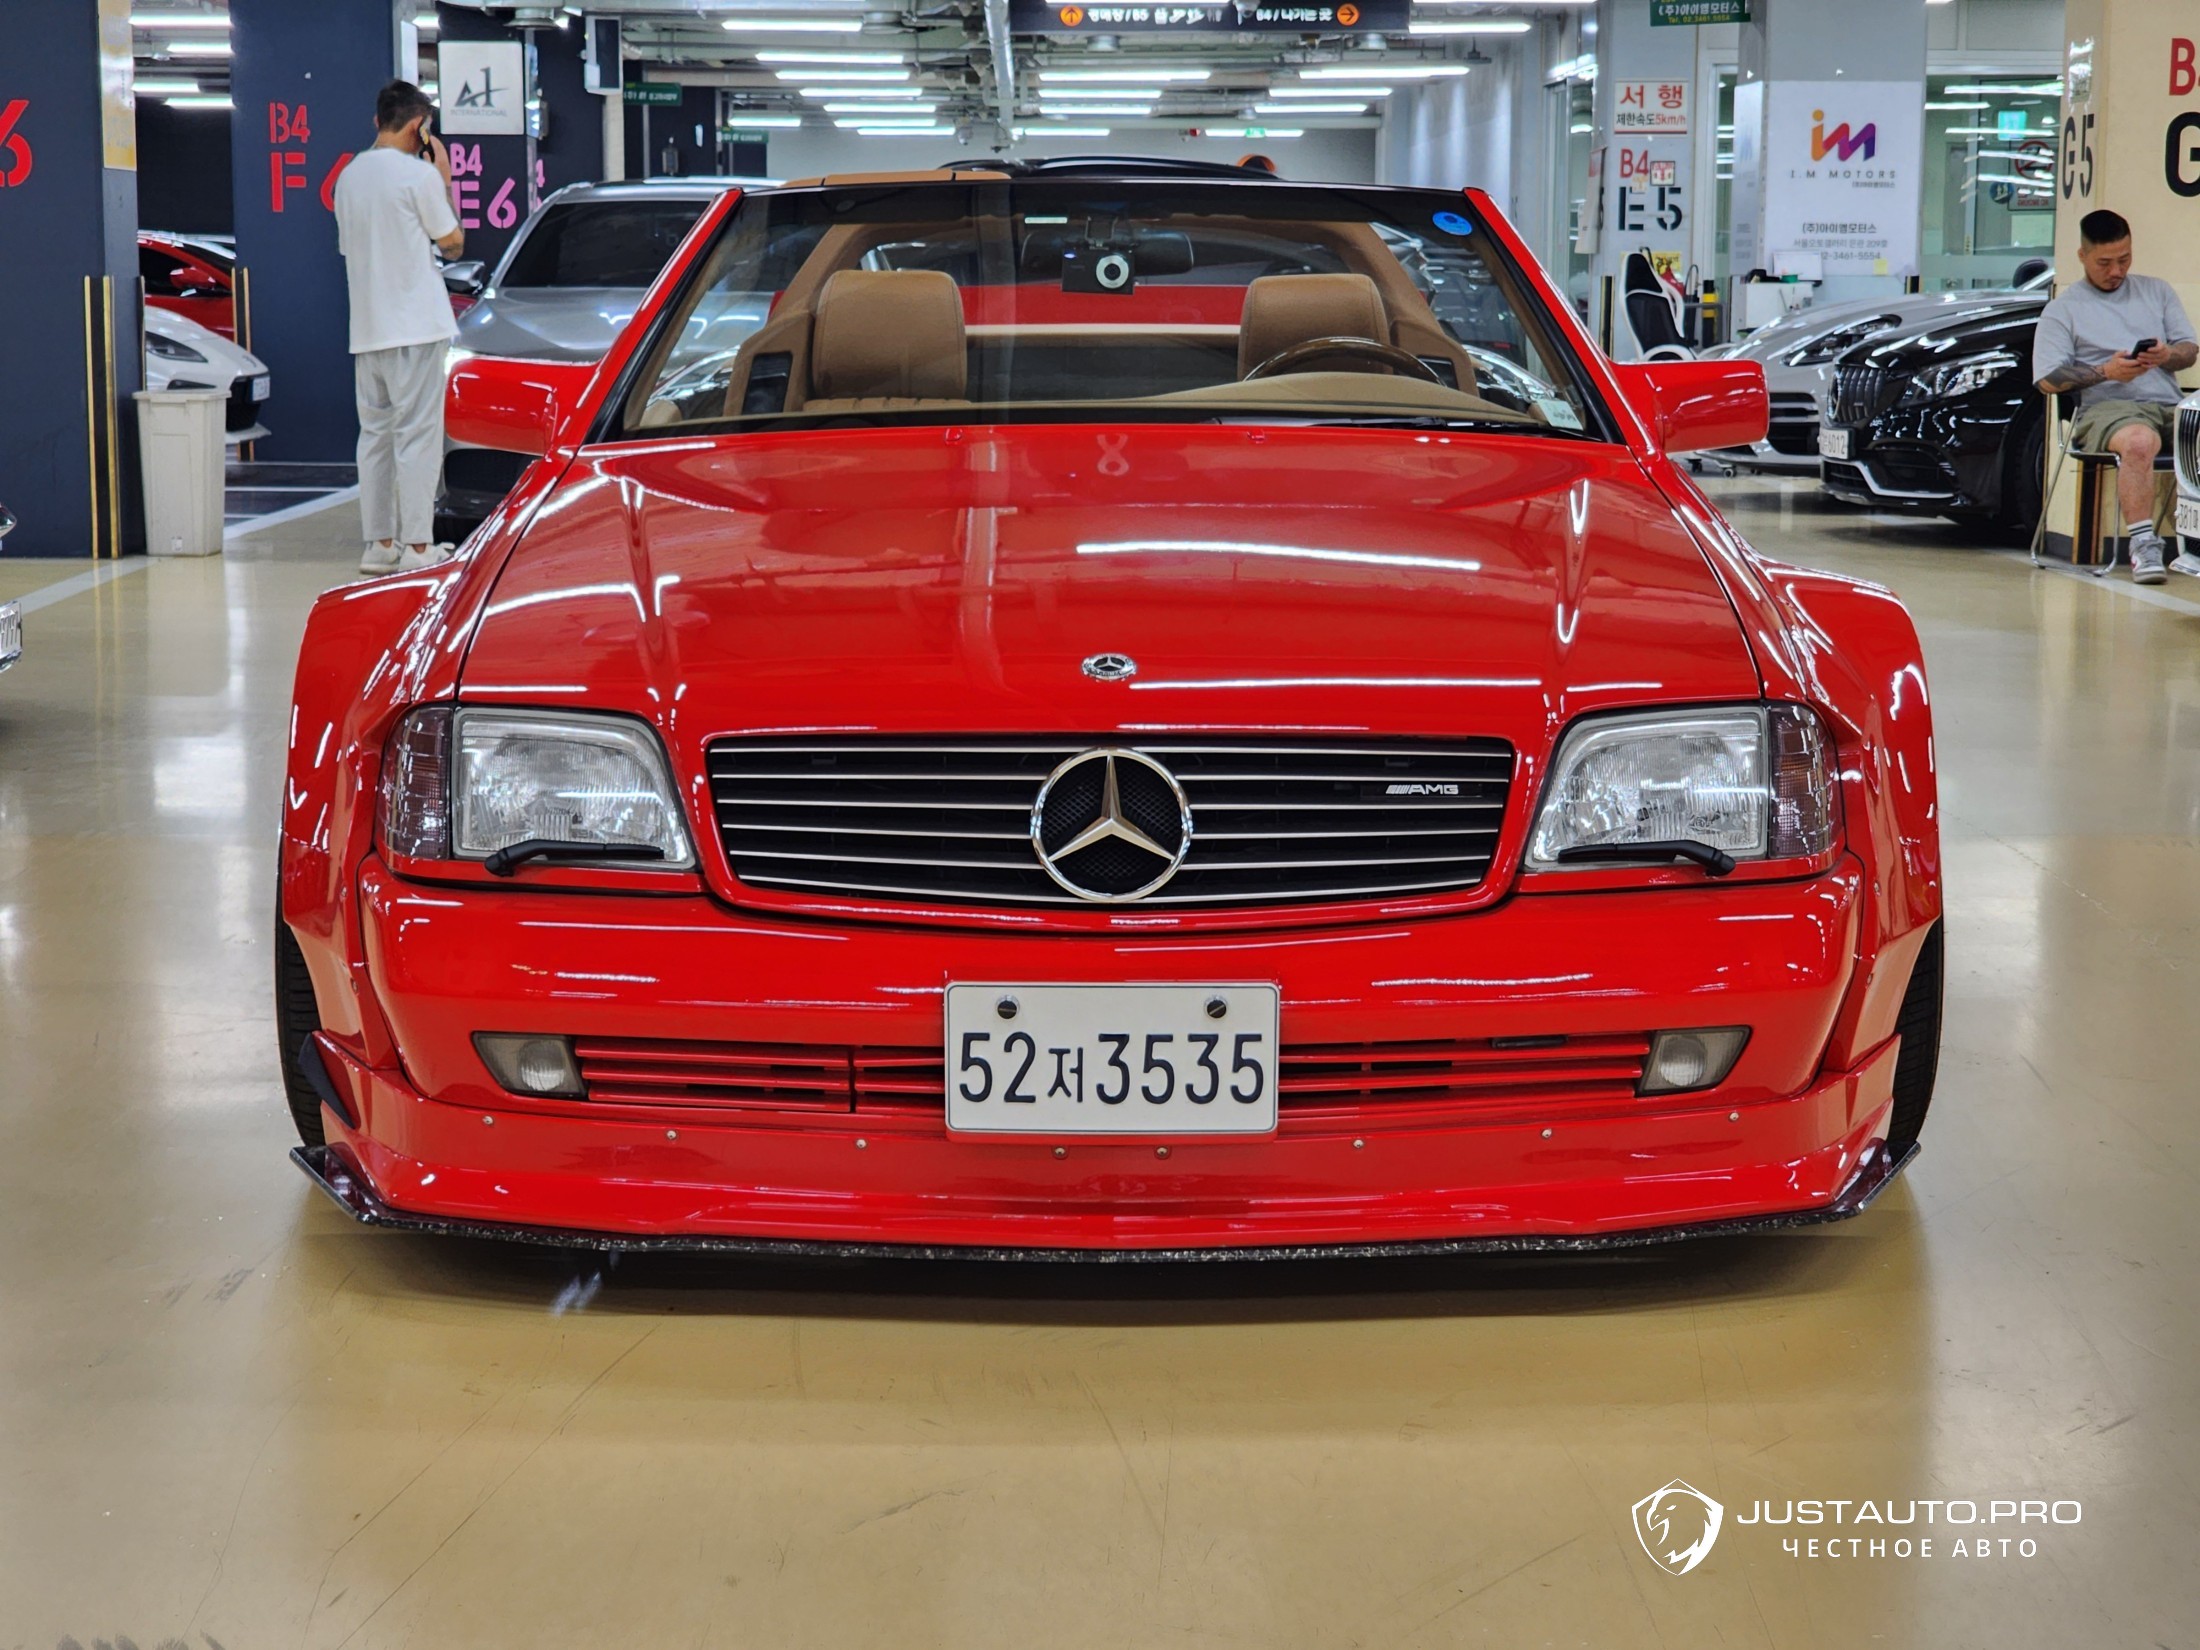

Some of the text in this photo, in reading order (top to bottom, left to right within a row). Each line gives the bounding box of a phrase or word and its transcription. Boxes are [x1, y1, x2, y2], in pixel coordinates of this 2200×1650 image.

[1658, 2, 1741, 16] (주)아이엠모터스
[2169, 38, 2200, 96] B
[270, 103, 311, 143] B4
[450, 143, 482, 176] B4
[1620, 148, 1649, 178] B4
[1829, 170, 1896, 179] MOTORS
[1803, 223, 1877, 234] (주)아이엠모터스
[1408, 784, 1459, 795] AMG
[959, 1031, 1265, 1105] 52저3535
